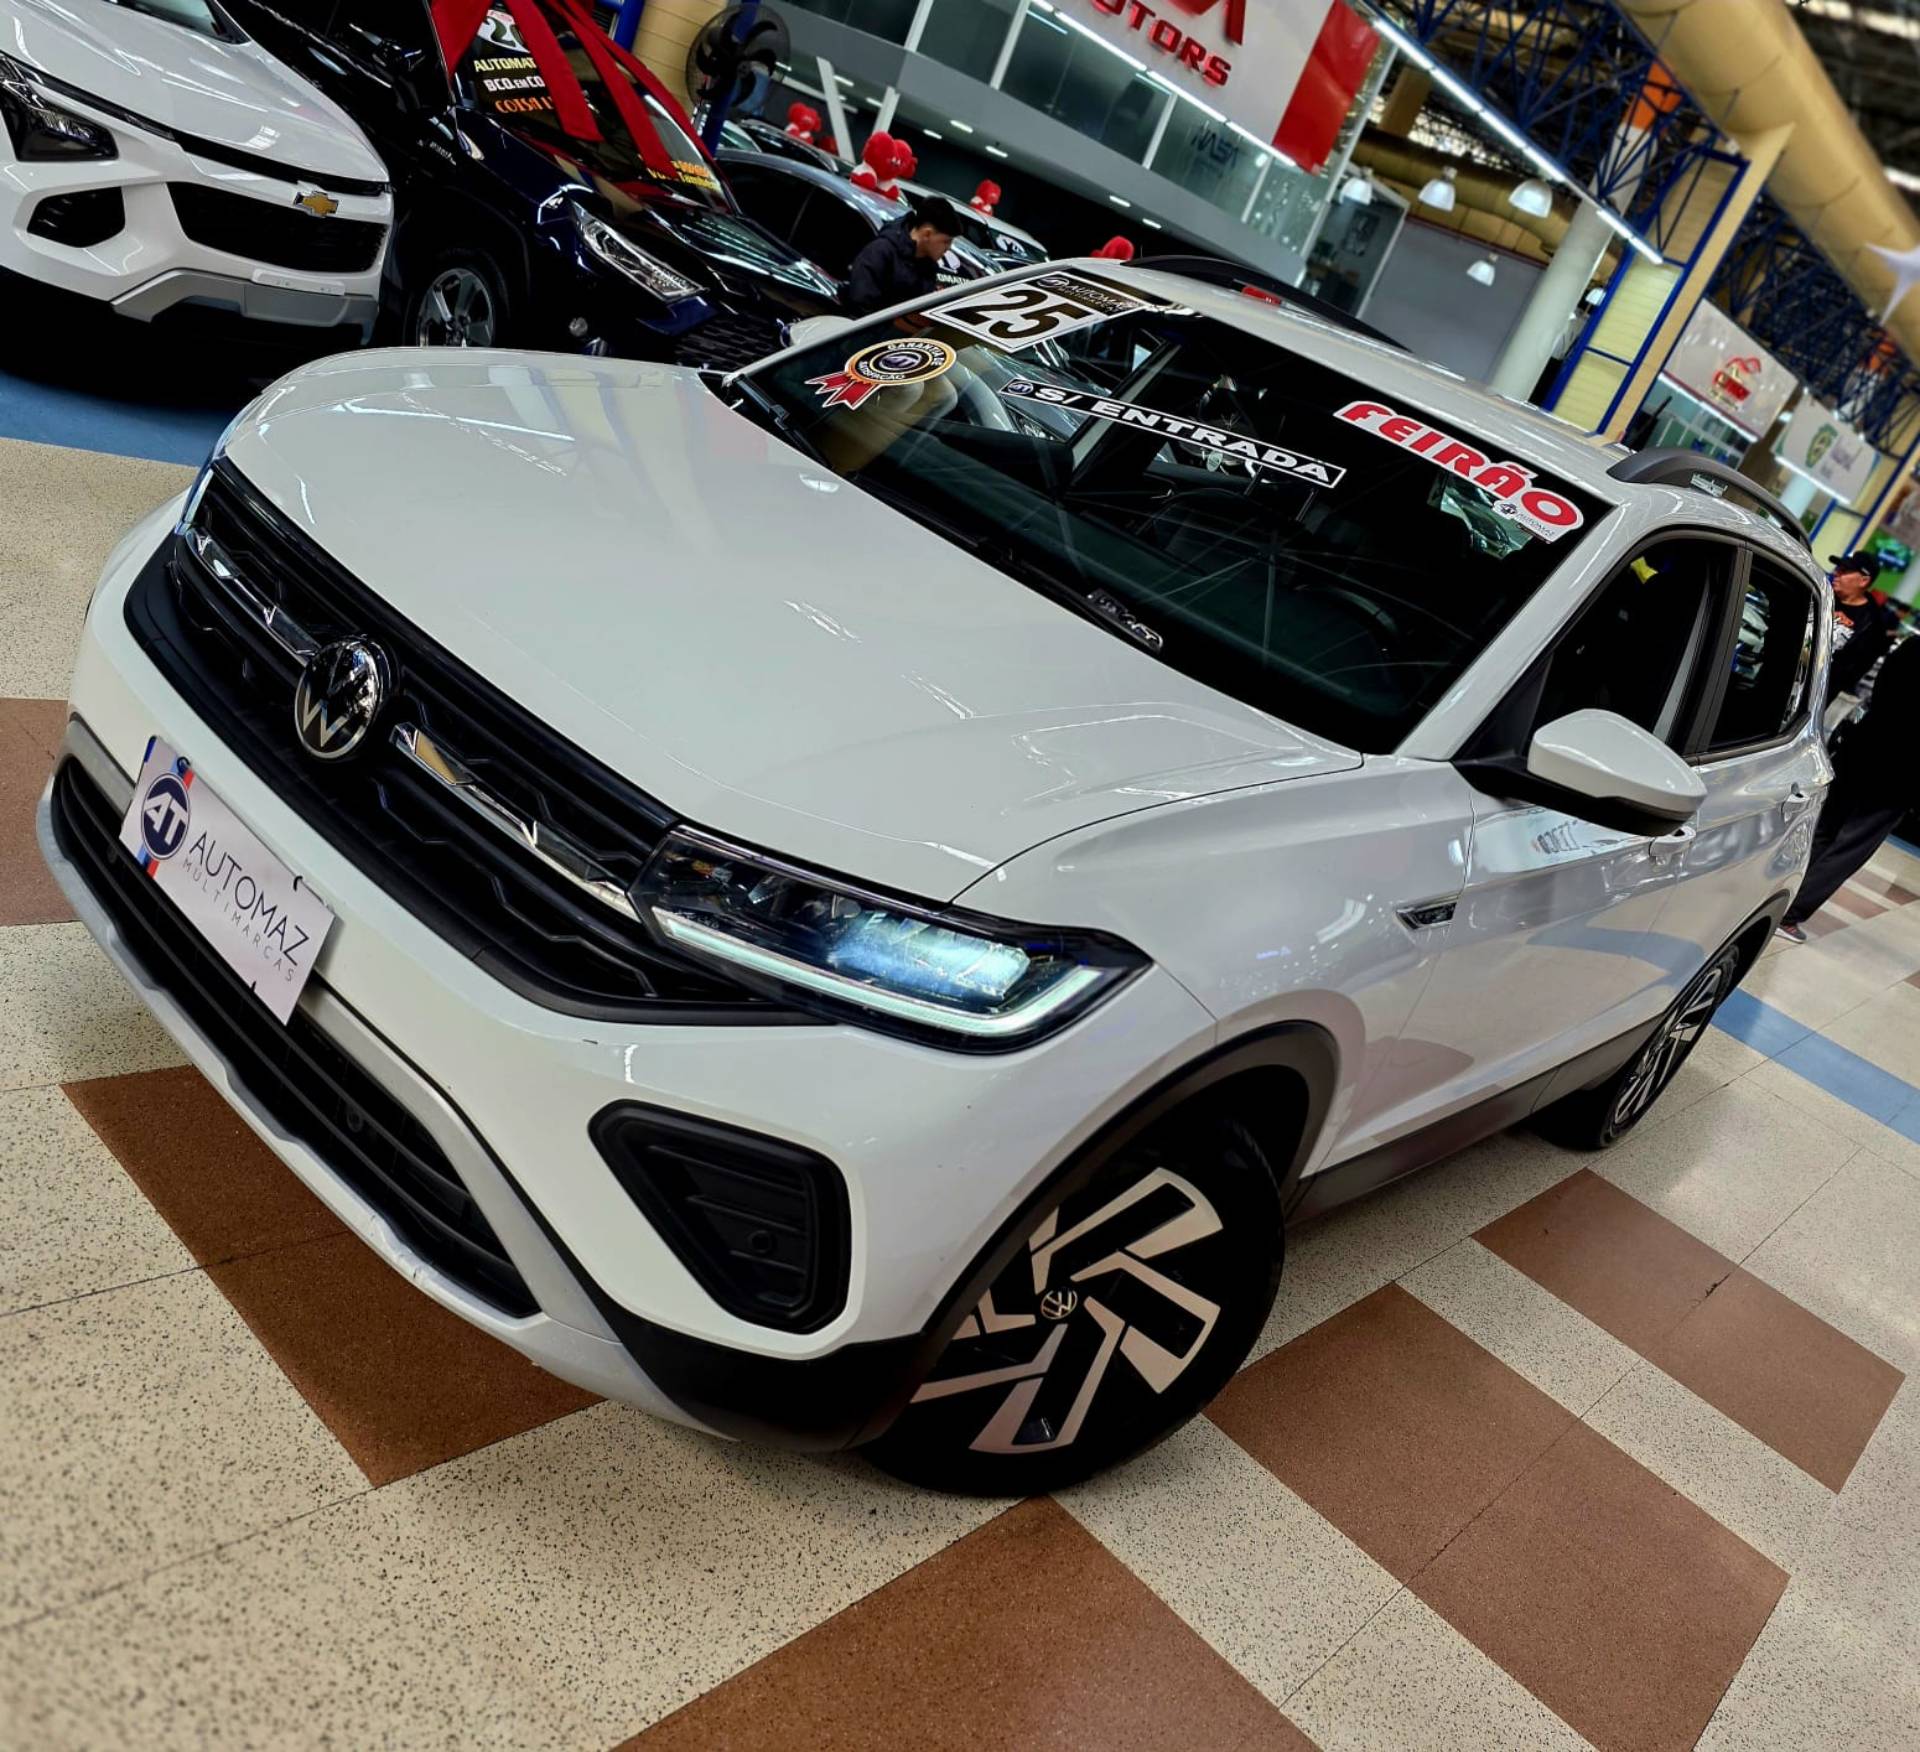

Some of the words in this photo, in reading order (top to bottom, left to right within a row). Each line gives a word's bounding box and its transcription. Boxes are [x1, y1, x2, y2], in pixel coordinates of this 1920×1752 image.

[942, 289, 1094, 339] 25
[1091, 402, 1329, 482] ENTRADA
[1342, 403, 1578, 526] FEIRÃO
[182, 858, 294, 982] MULTIMARCAS
[189, 830, 309, 966] AUTOMAZ
